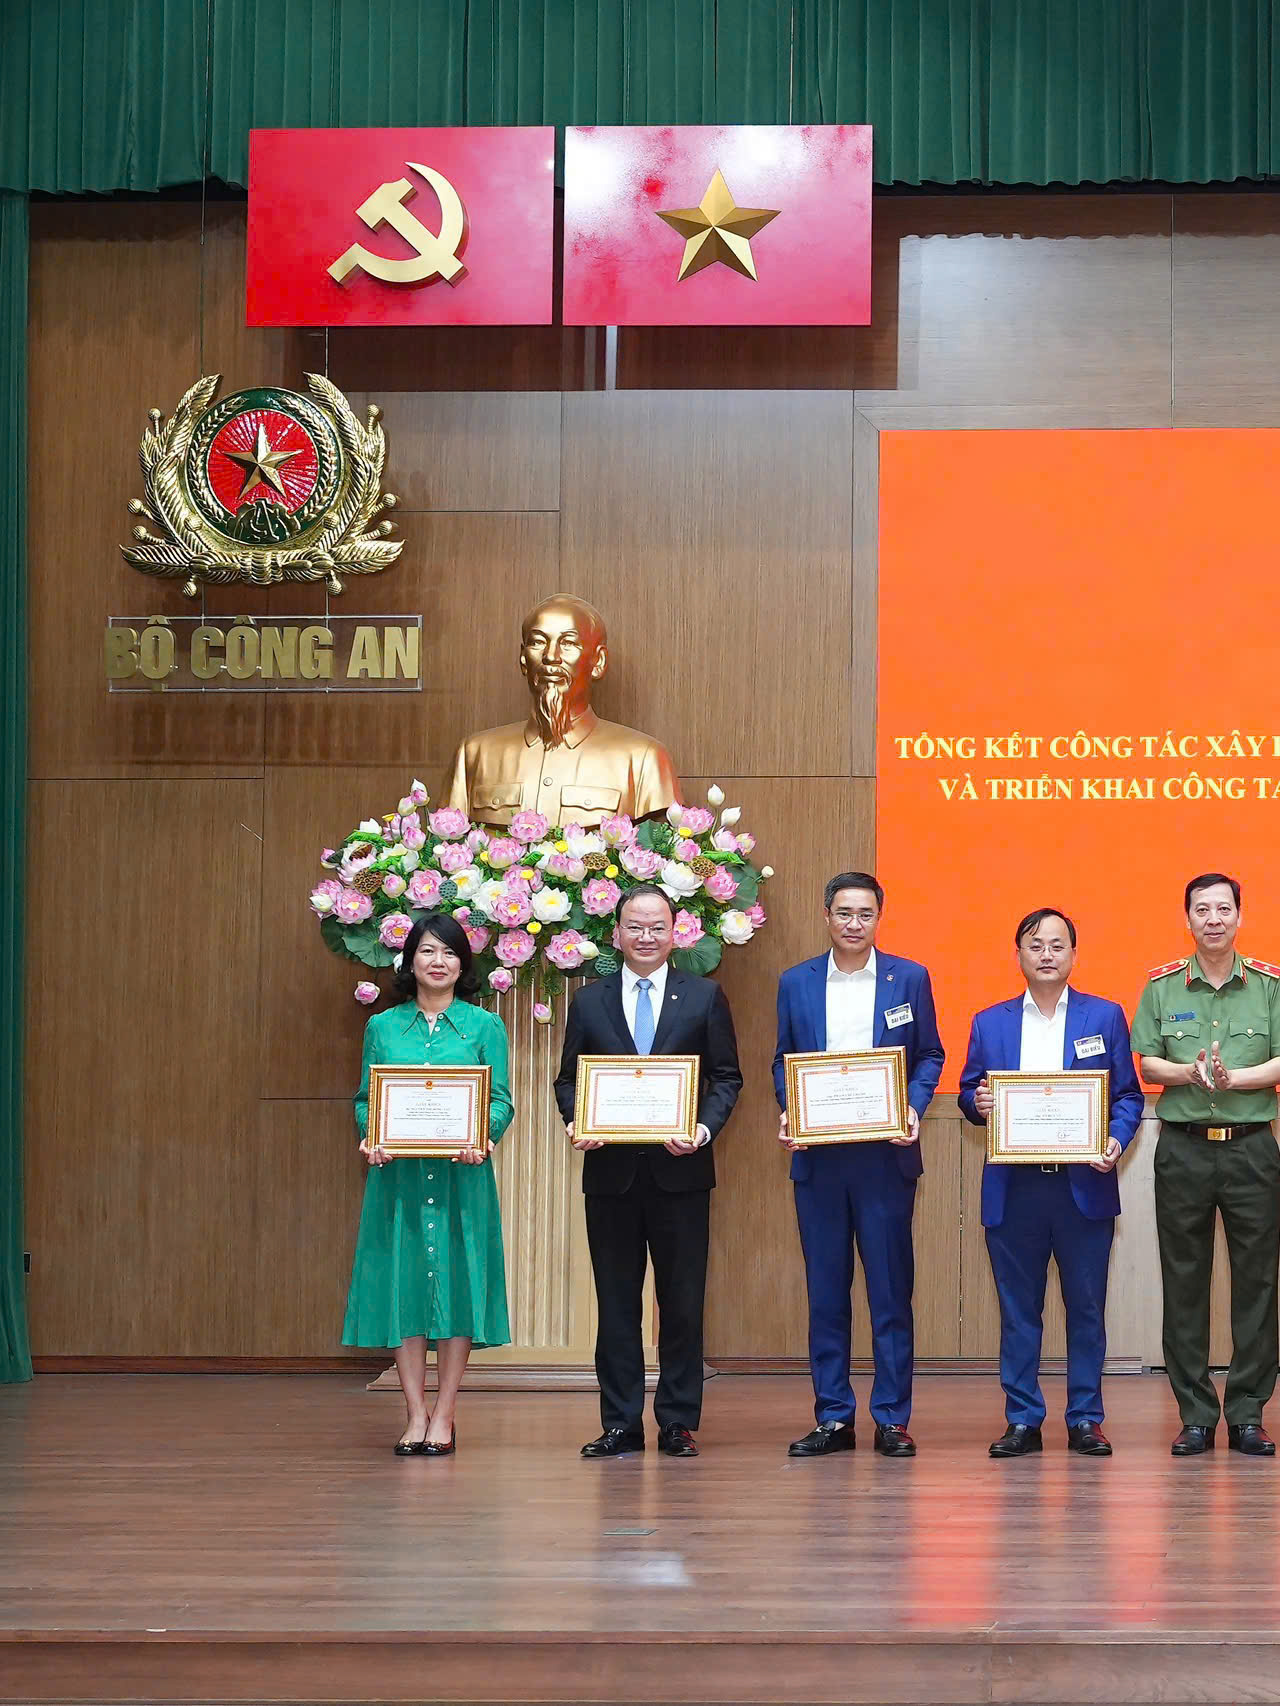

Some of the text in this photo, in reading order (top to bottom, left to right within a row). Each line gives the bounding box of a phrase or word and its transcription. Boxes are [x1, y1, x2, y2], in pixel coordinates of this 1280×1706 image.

[190, 615, 336, 681] CÔNG
[347, 626, 420, 680] AN
[894, 731, 977, 759] TỔNG
[983, 731, 1044, 759] KẾT
[1049, 729, 1134, 759] CÔNG
[1139, 730, 1199, 758] TÁC
[1205, 729, 1267, 758] XÂY
[938, 772, 979, 801] VÀ
[984, 768, 1074, 801] TRIỂN
[1080, 777, 1156, 800] KHAI
[1162, 771, 1247, 800] CÔNG
